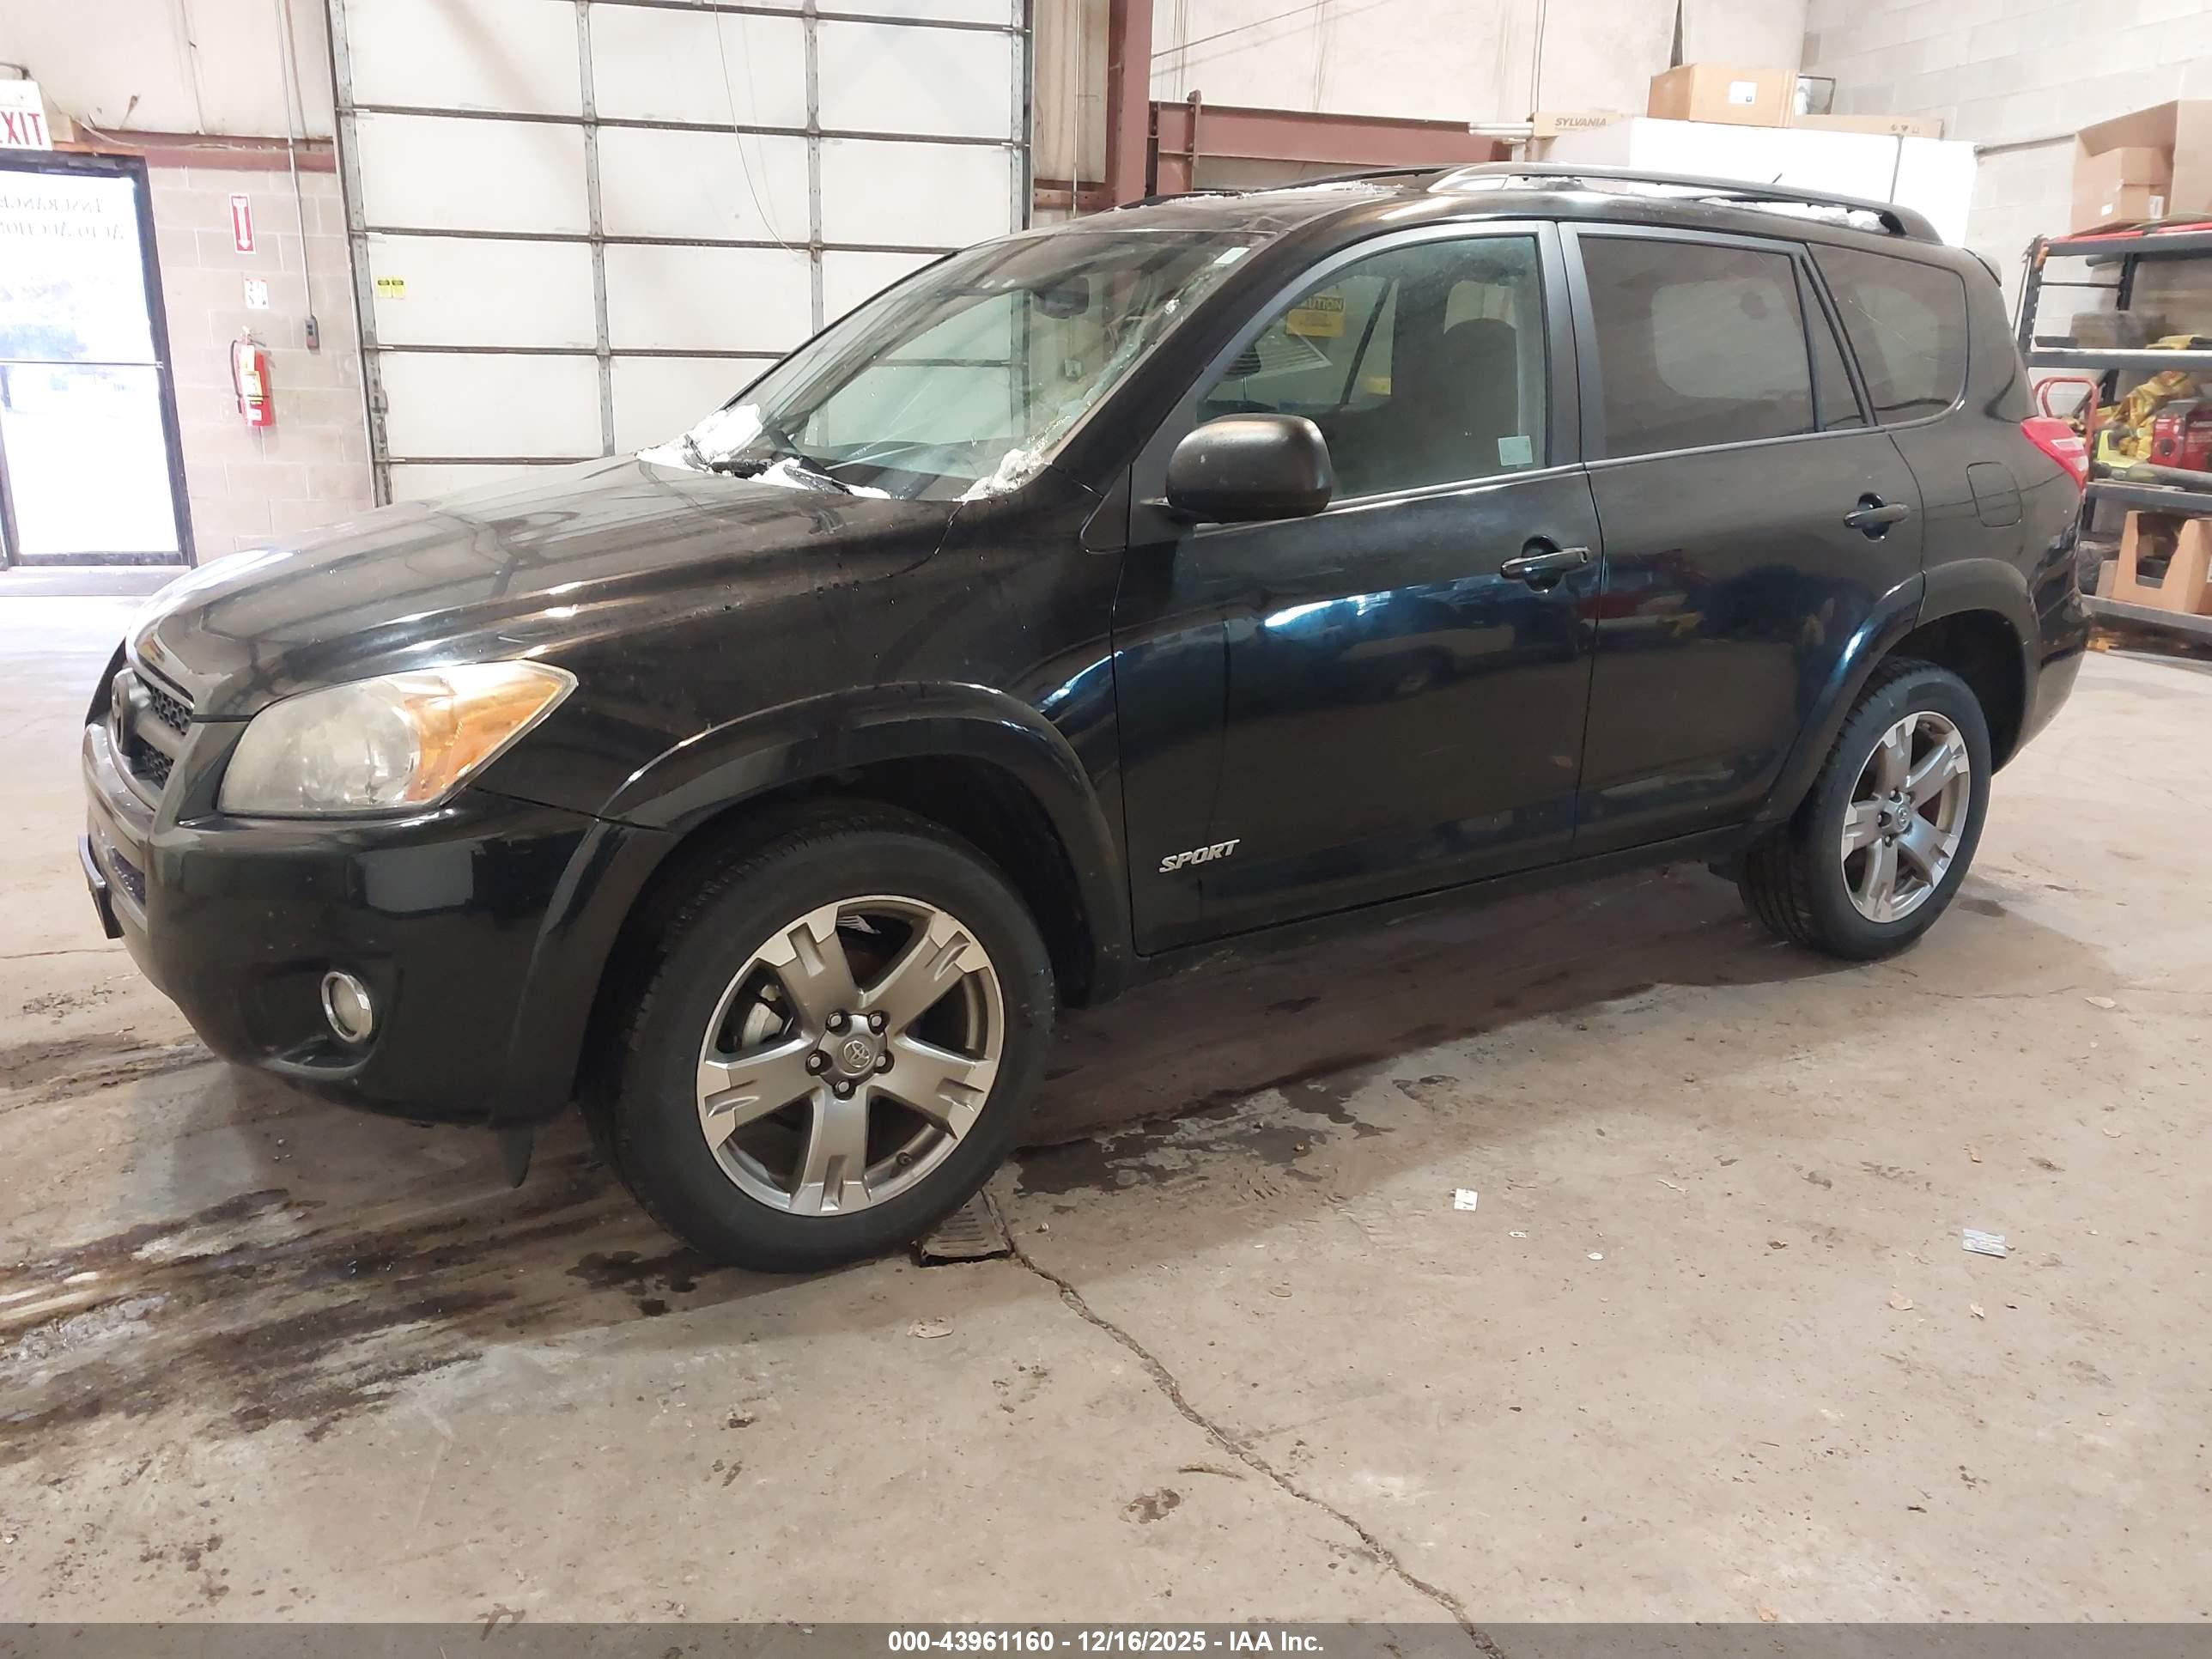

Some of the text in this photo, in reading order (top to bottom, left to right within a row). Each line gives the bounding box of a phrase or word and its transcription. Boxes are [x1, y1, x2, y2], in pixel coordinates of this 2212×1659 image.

[0, 111, 42, 145] XIT
[1555, 118, 1607, 126] SYLVANIA
[1158, 838, 1241, 873] SPORT
